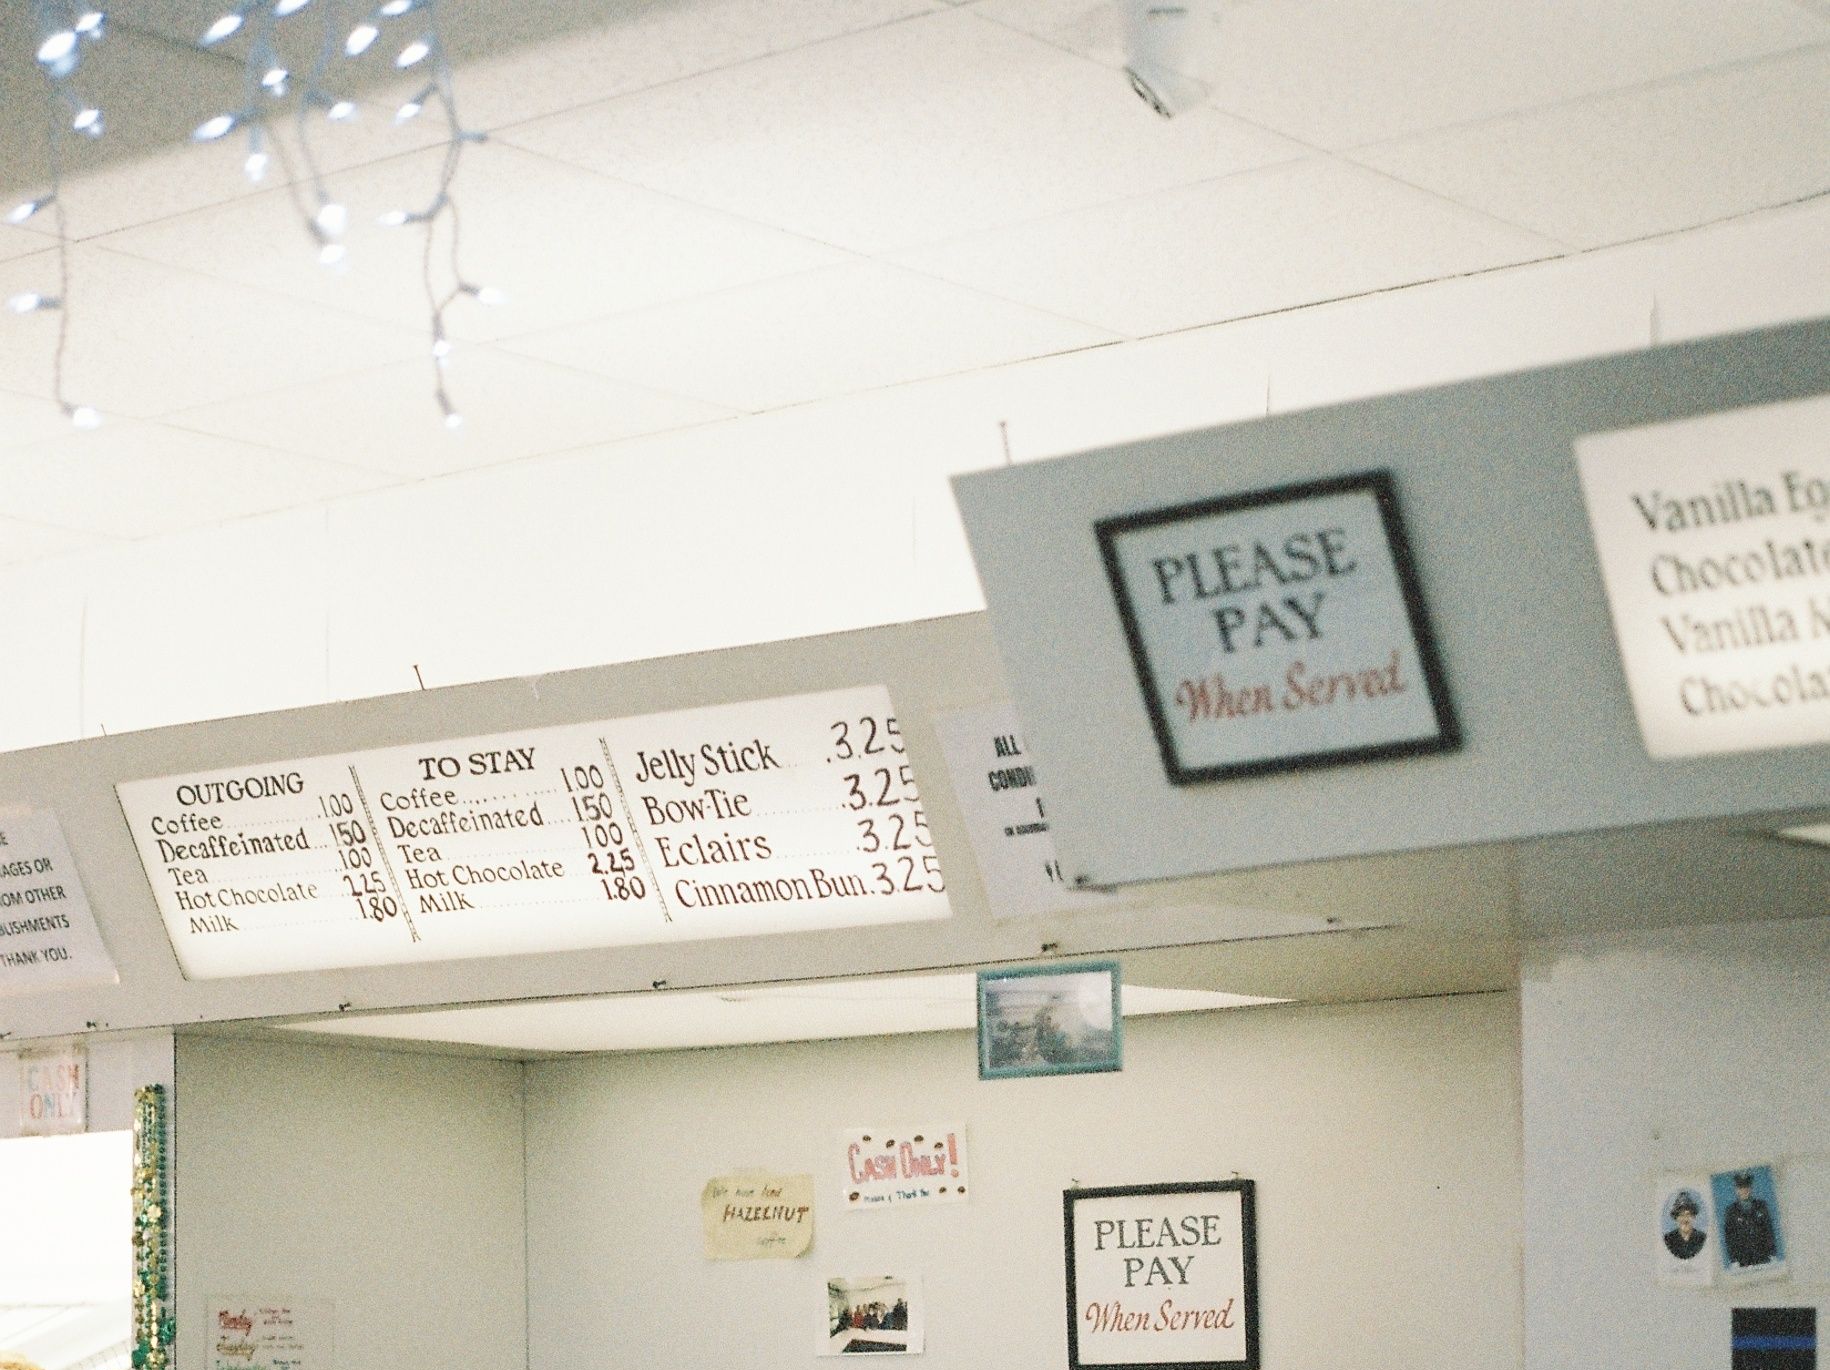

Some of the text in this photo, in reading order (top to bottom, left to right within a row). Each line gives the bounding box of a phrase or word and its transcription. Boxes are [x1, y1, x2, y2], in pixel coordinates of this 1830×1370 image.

[1632, 479, 1777, 531] Vanilla
[1152, 527, 1357, 605] PLEASE
[1213, 591, 1327, 653] PAY
[1174, 650, 1406, 724] When Served
[419, 748, 536, 781] TO STAY
[635, 749, 697, 787] Jelly
[700, 739, 782, 776] Stick
[176, 772, 304, 806] OUTGOING
[380, 788, 459, 812] Coffee
[152, 812, 223, 836] Coffee
[387, 802, 544, 839] Decaffeinated
[157, 831, 311, 863] Decaffeinated
[397, 844, 442, 865] Tea
[655, 832, 772, 868] Eclairs
[0, 857, 53, 878] AGES OR
[168, 867, 208, 887] Tea
[406, 869, 449, 890] Hot
[452, 860, 566, 886] Chocolate
[25, 885, 67, 904] OTHER
[175, 889, 218, 911] Hot
[218, 882, 319, 907] Chocolate
[419, 876, 646, 914] Milk 1.80
[675, 873, 814, 909] Cinnamon
[189, 895, 398, 935] Milk 1.80
[40, 947, 72, 962] YOU.
[723, 1204, 809, 1223] HAZELNUT
[1093, 1214, 1222, 1251] PLEASE
[1123, 1255, 1195, 1288] PAY
[1085, 1298, 1236, 1333] When Served
